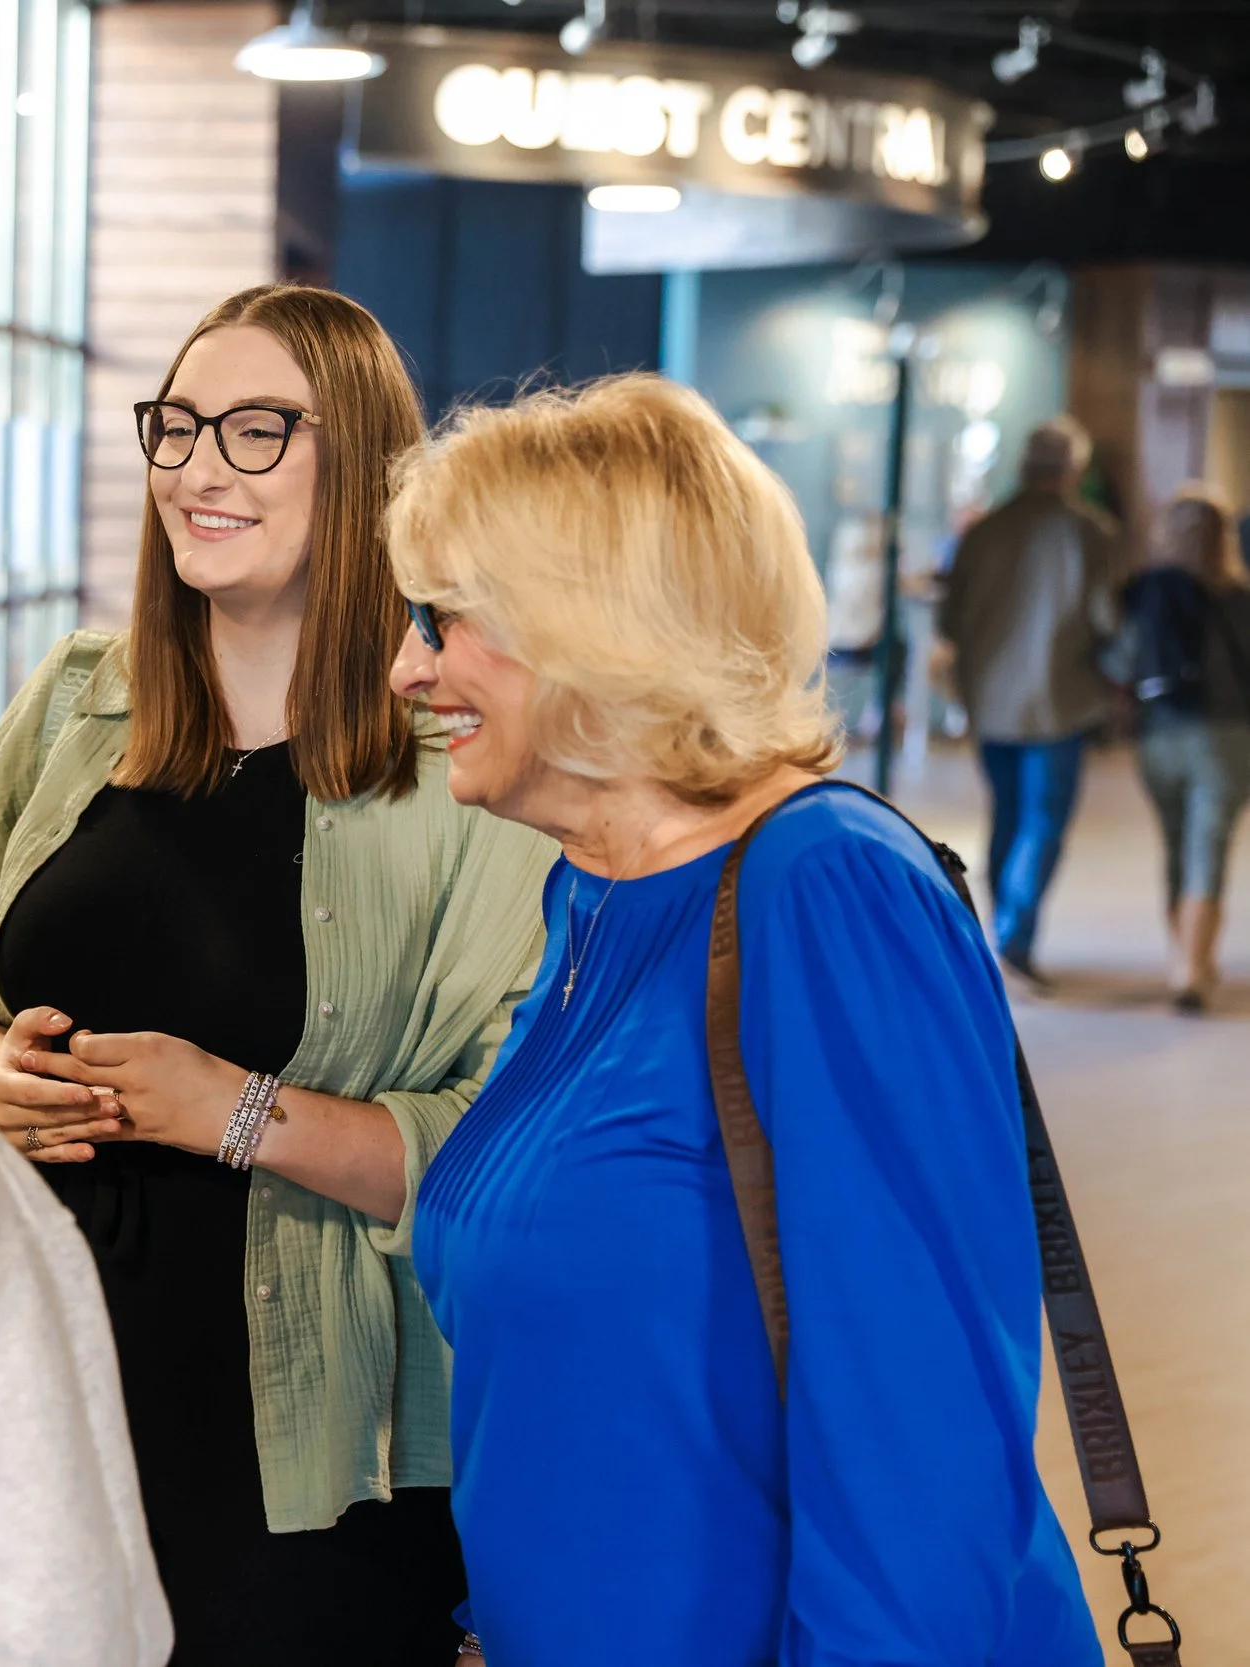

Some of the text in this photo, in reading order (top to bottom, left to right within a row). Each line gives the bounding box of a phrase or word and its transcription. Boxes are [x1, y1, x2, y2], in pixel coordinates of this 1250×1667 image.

[221, 1111, 236, 1150] AUNTIE
[230, 1109, 248, 1146] TIMING
[1057, 1327, 1129, 1483] BRIXLEY
